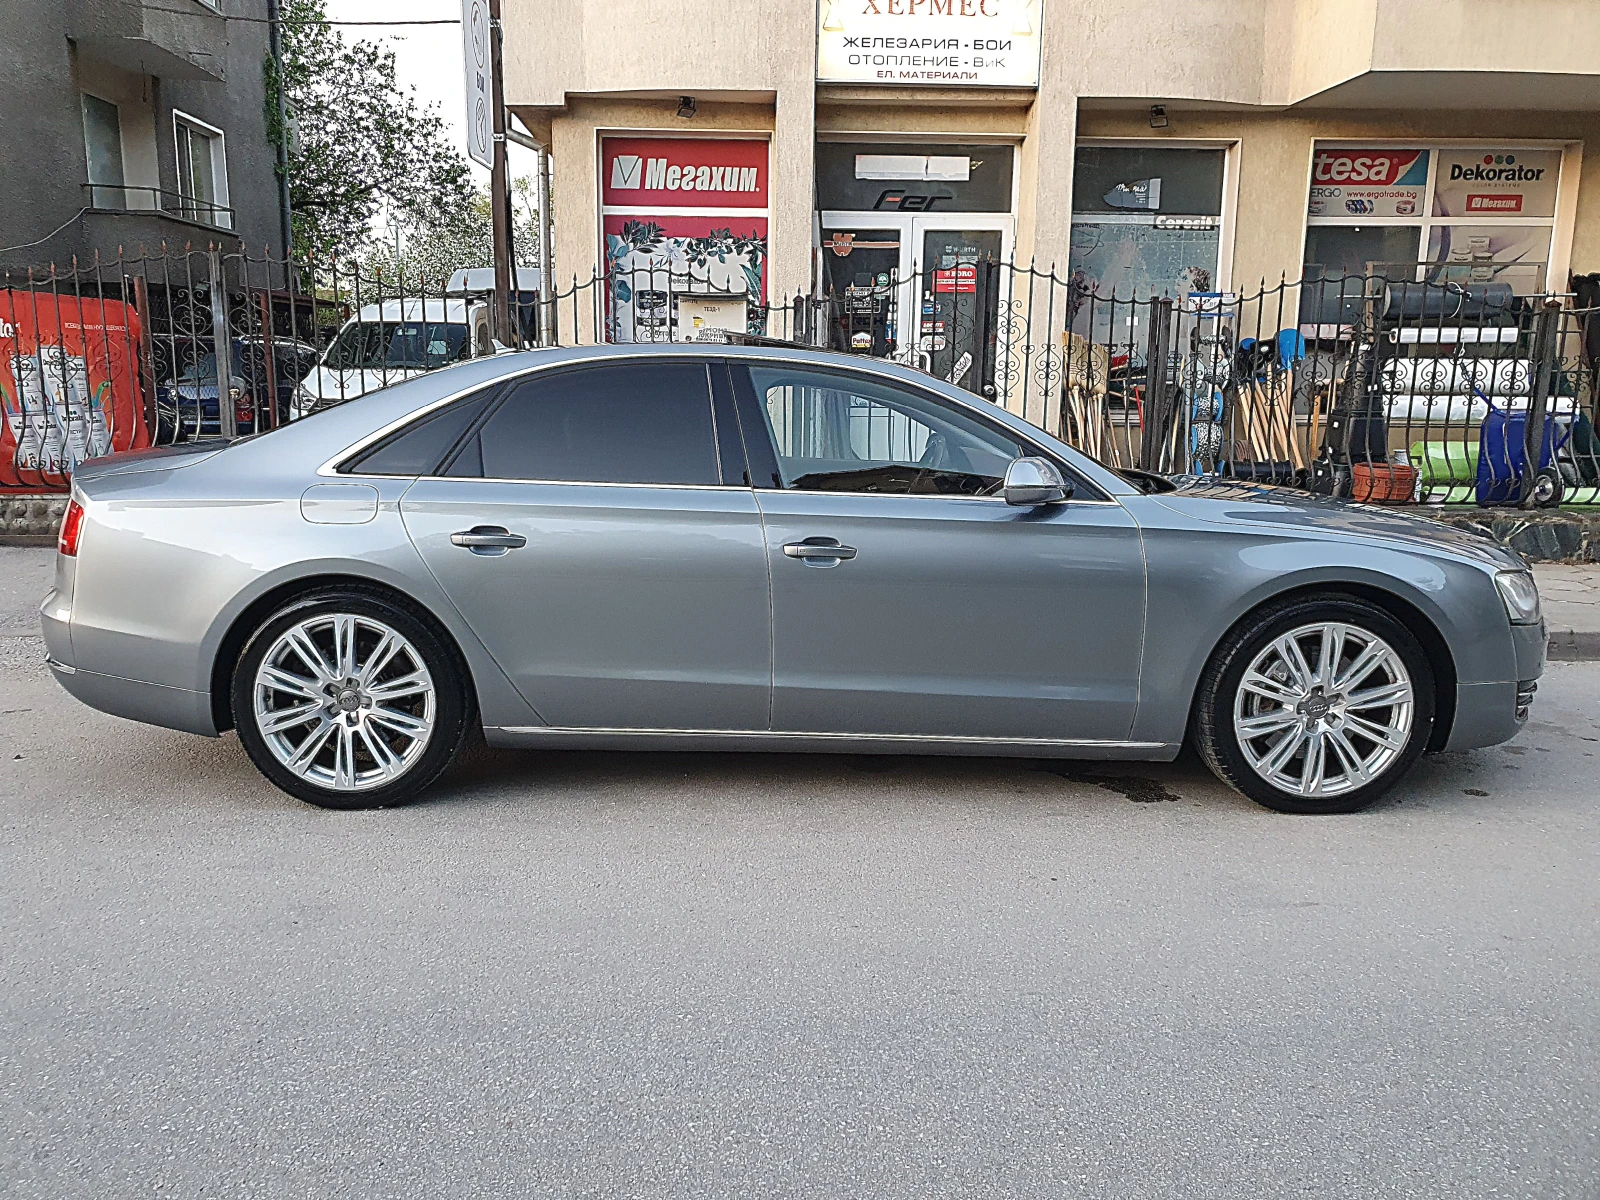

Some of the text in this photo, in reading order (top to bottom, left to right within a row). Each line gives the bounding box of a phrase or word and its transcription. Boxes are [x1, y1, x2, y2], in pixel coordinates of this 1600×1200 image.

[862, 0, 998, 17] ХЕРМЕС
[843, 36, 1012, 50] ЖЕЛЕЗАРИЯ БОИ
[848, 54, 959, 67] ОТОПЛЕНИЕ
[876, 70, 978, 79] ЕЛ. МАТЕРИАЛИ
[1313, 153, 1391, 181] tesa
[1449, 164, 1545, 181] Dekorator
[644, 158, 758, 192] Мегахим
[1310, 188, 1417, 199] ERGO www.ergotrade.bg
